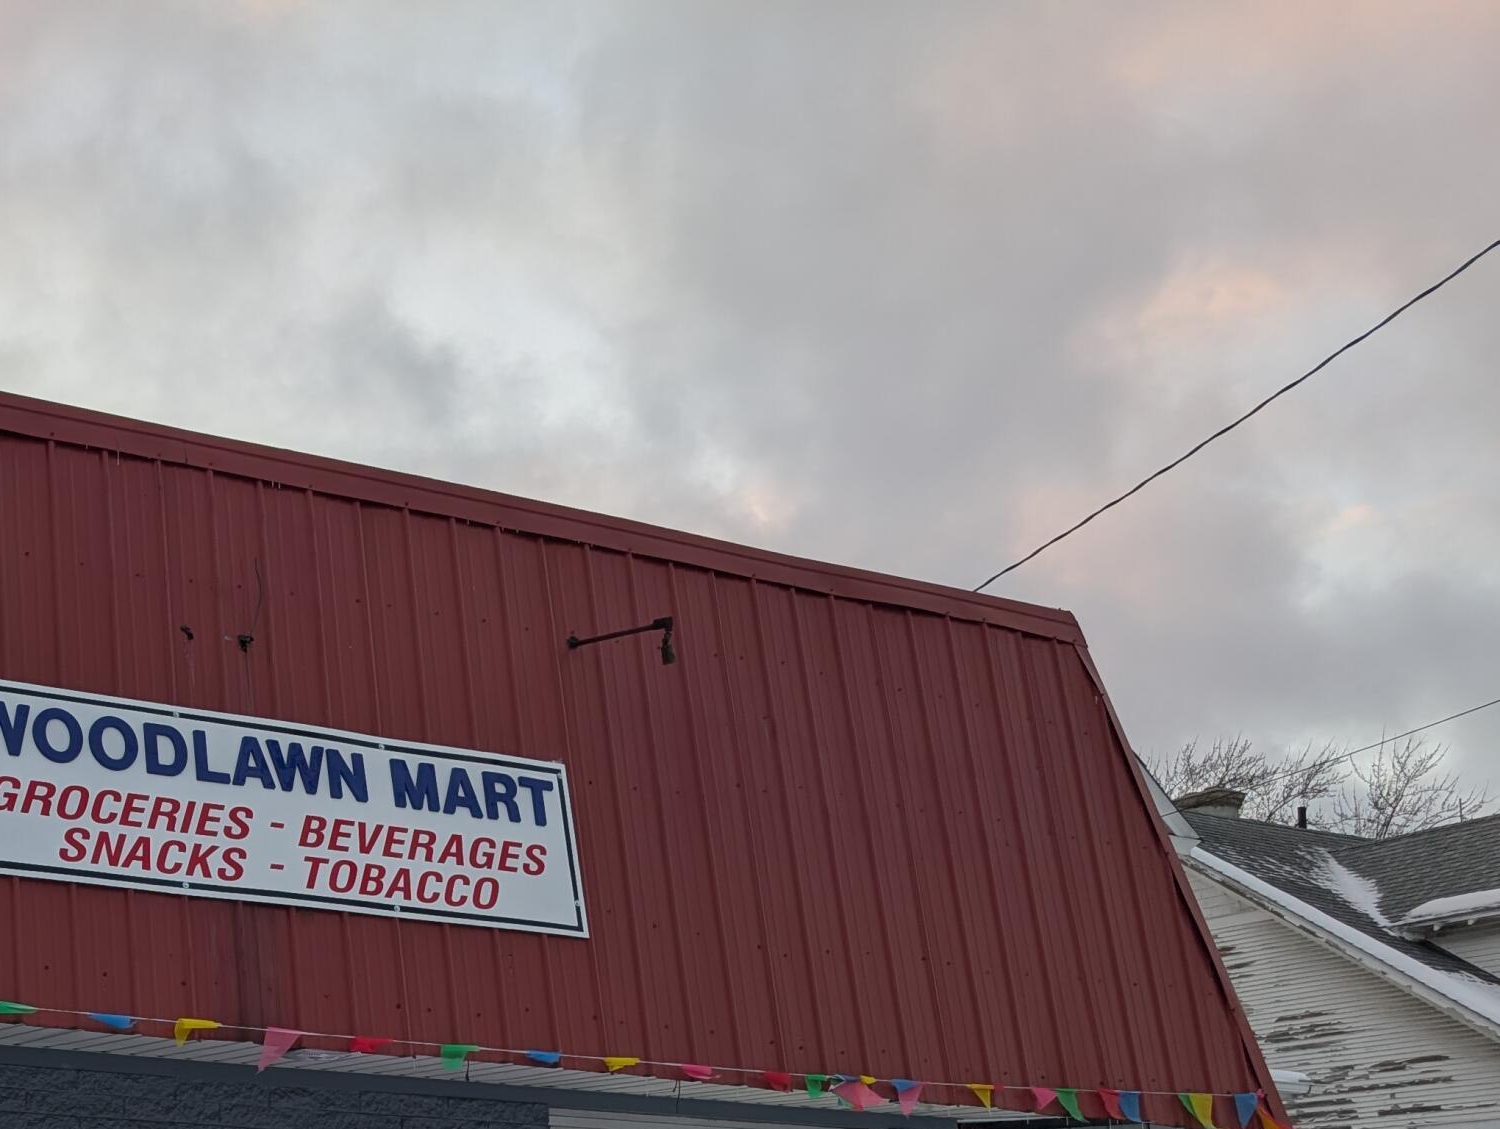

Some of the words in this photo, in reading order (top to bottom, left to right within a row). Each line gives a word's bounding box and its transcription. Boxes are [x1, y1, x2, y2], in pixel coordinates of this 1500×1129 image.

[389, 757, 554, 827] MART
[59, 828, 248, 881] SNACKS
[304, 857, 501, 910] TOBACCO
[298, 815, 548, 876] BEVERAGES
